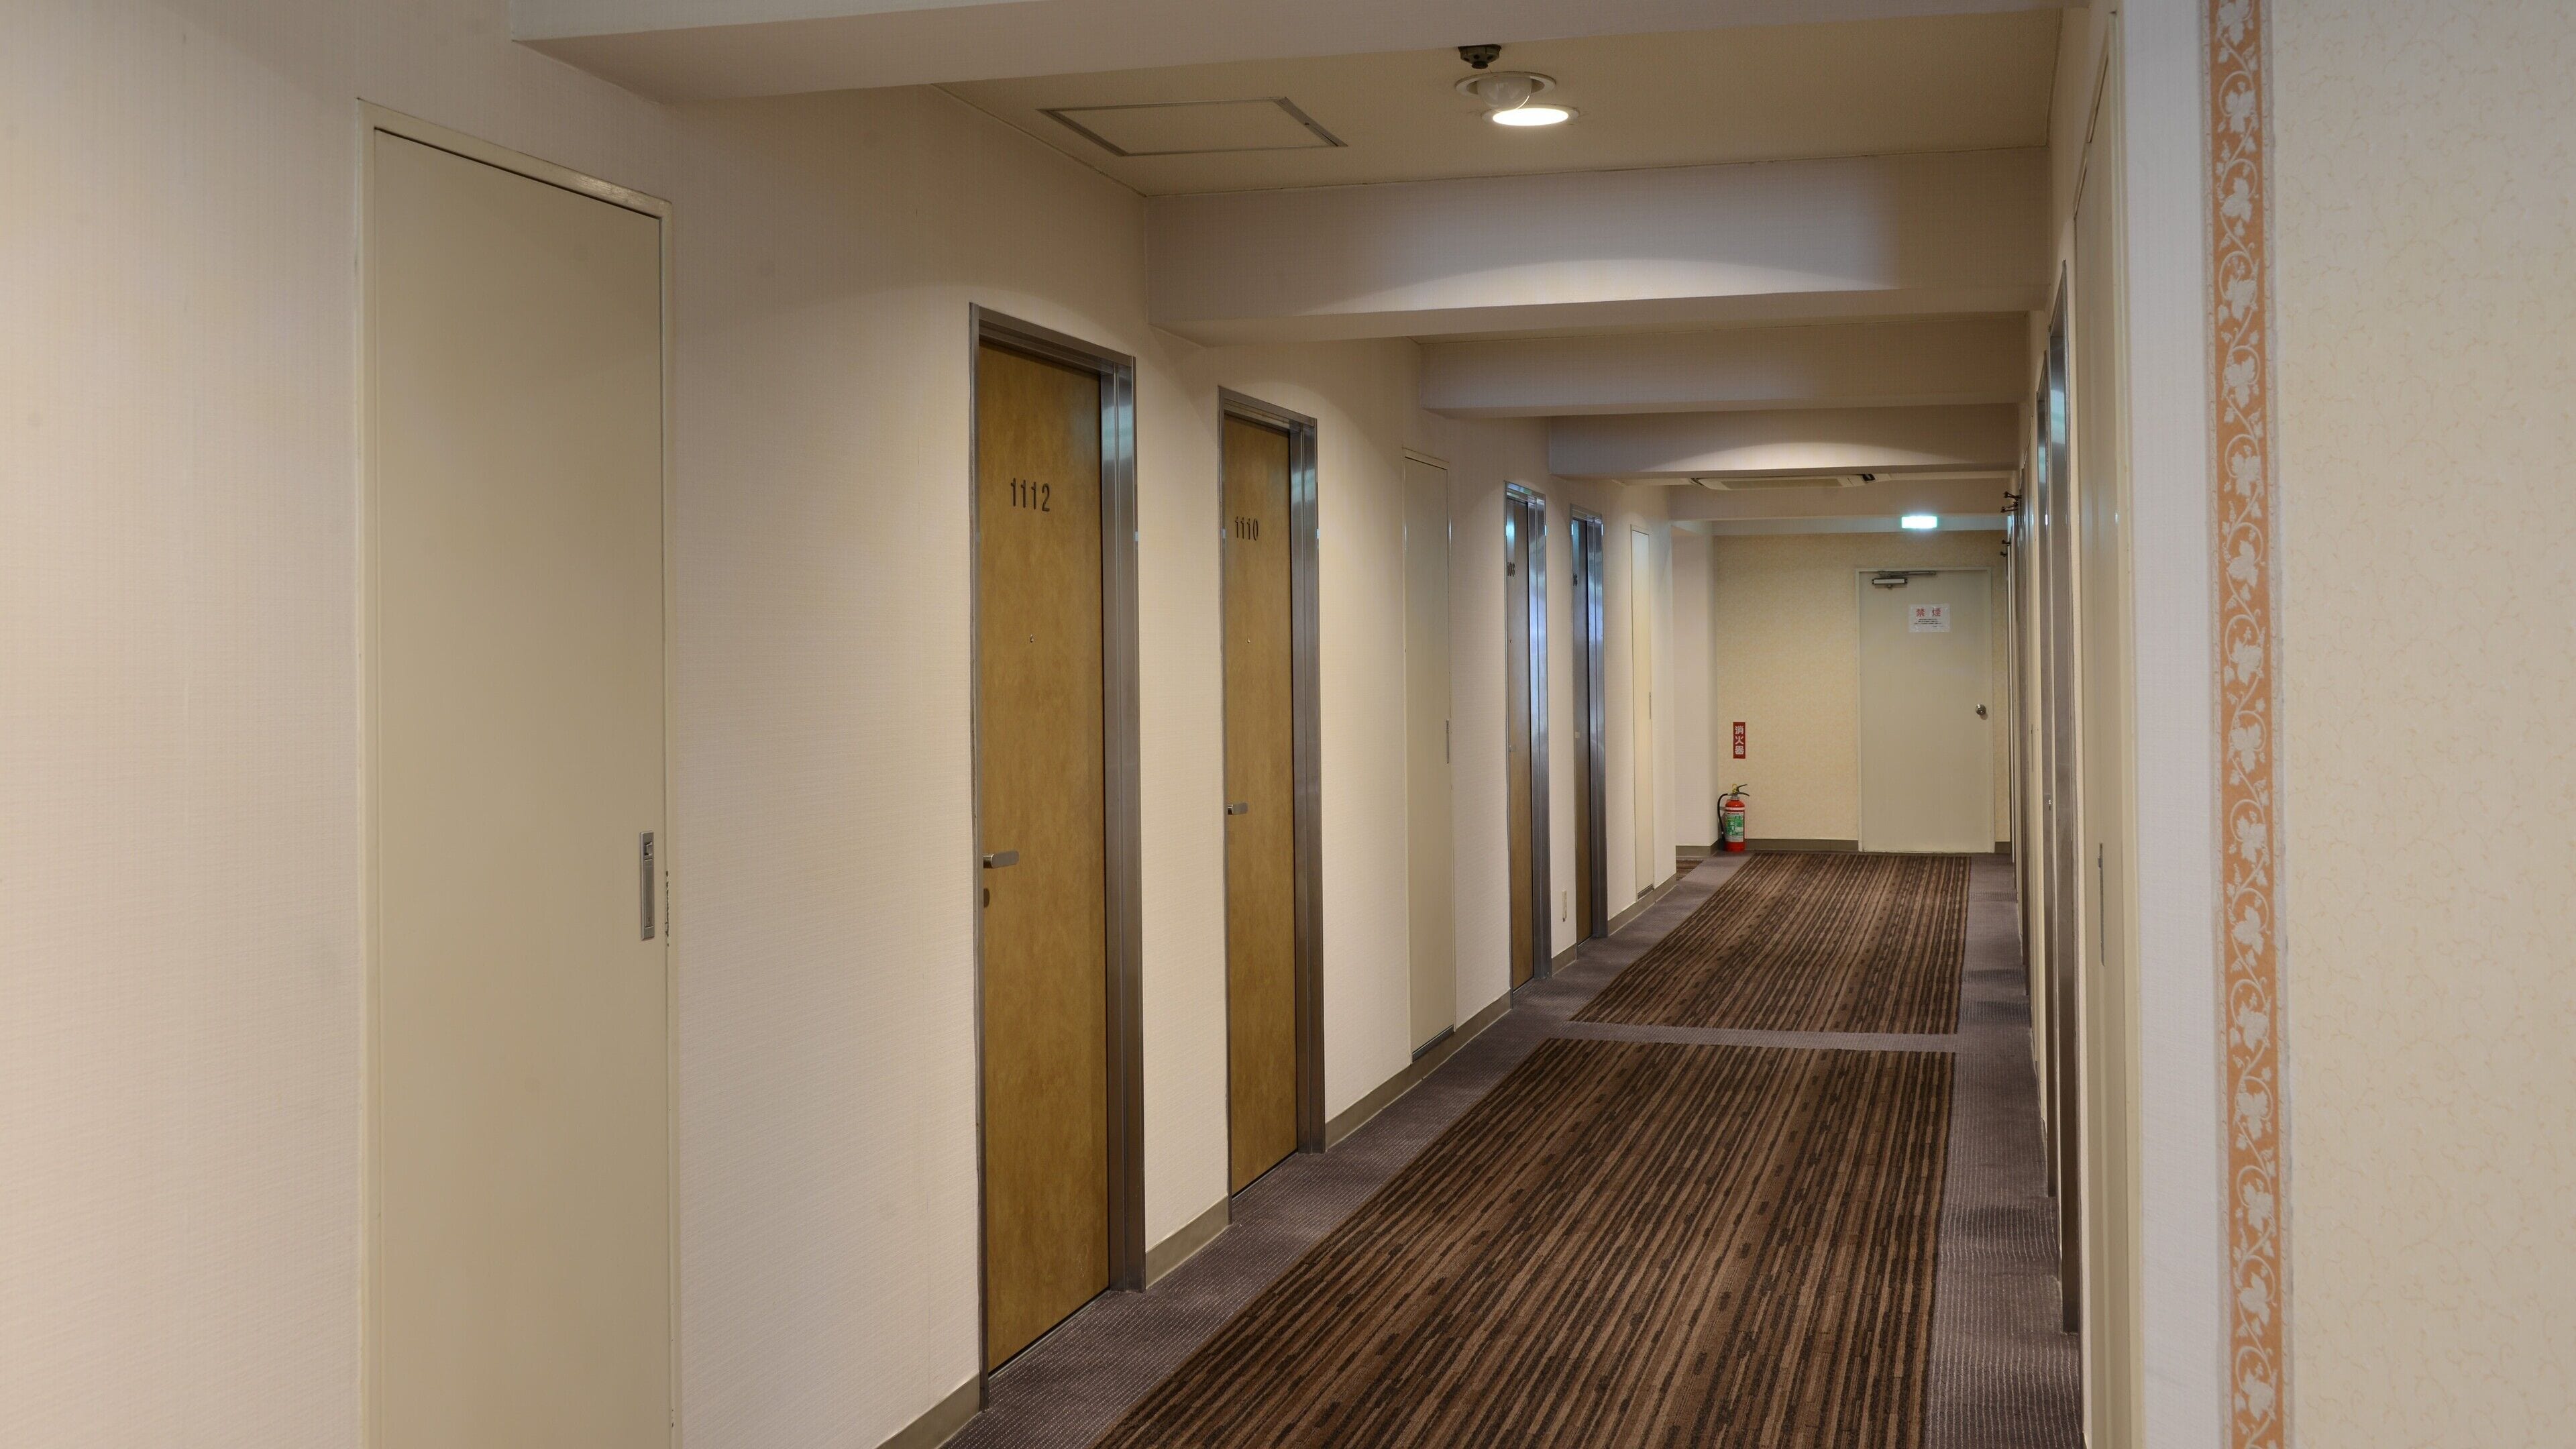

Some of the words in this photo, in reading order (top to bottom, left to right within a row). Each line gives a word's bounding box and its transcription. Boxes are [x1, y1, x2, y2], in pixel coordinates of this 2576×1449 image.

[1010, 477, 1051, 512] 1112
[1235, 516, 1258, 541] 1110
[1735, 725, 1744, 755] 消火器
